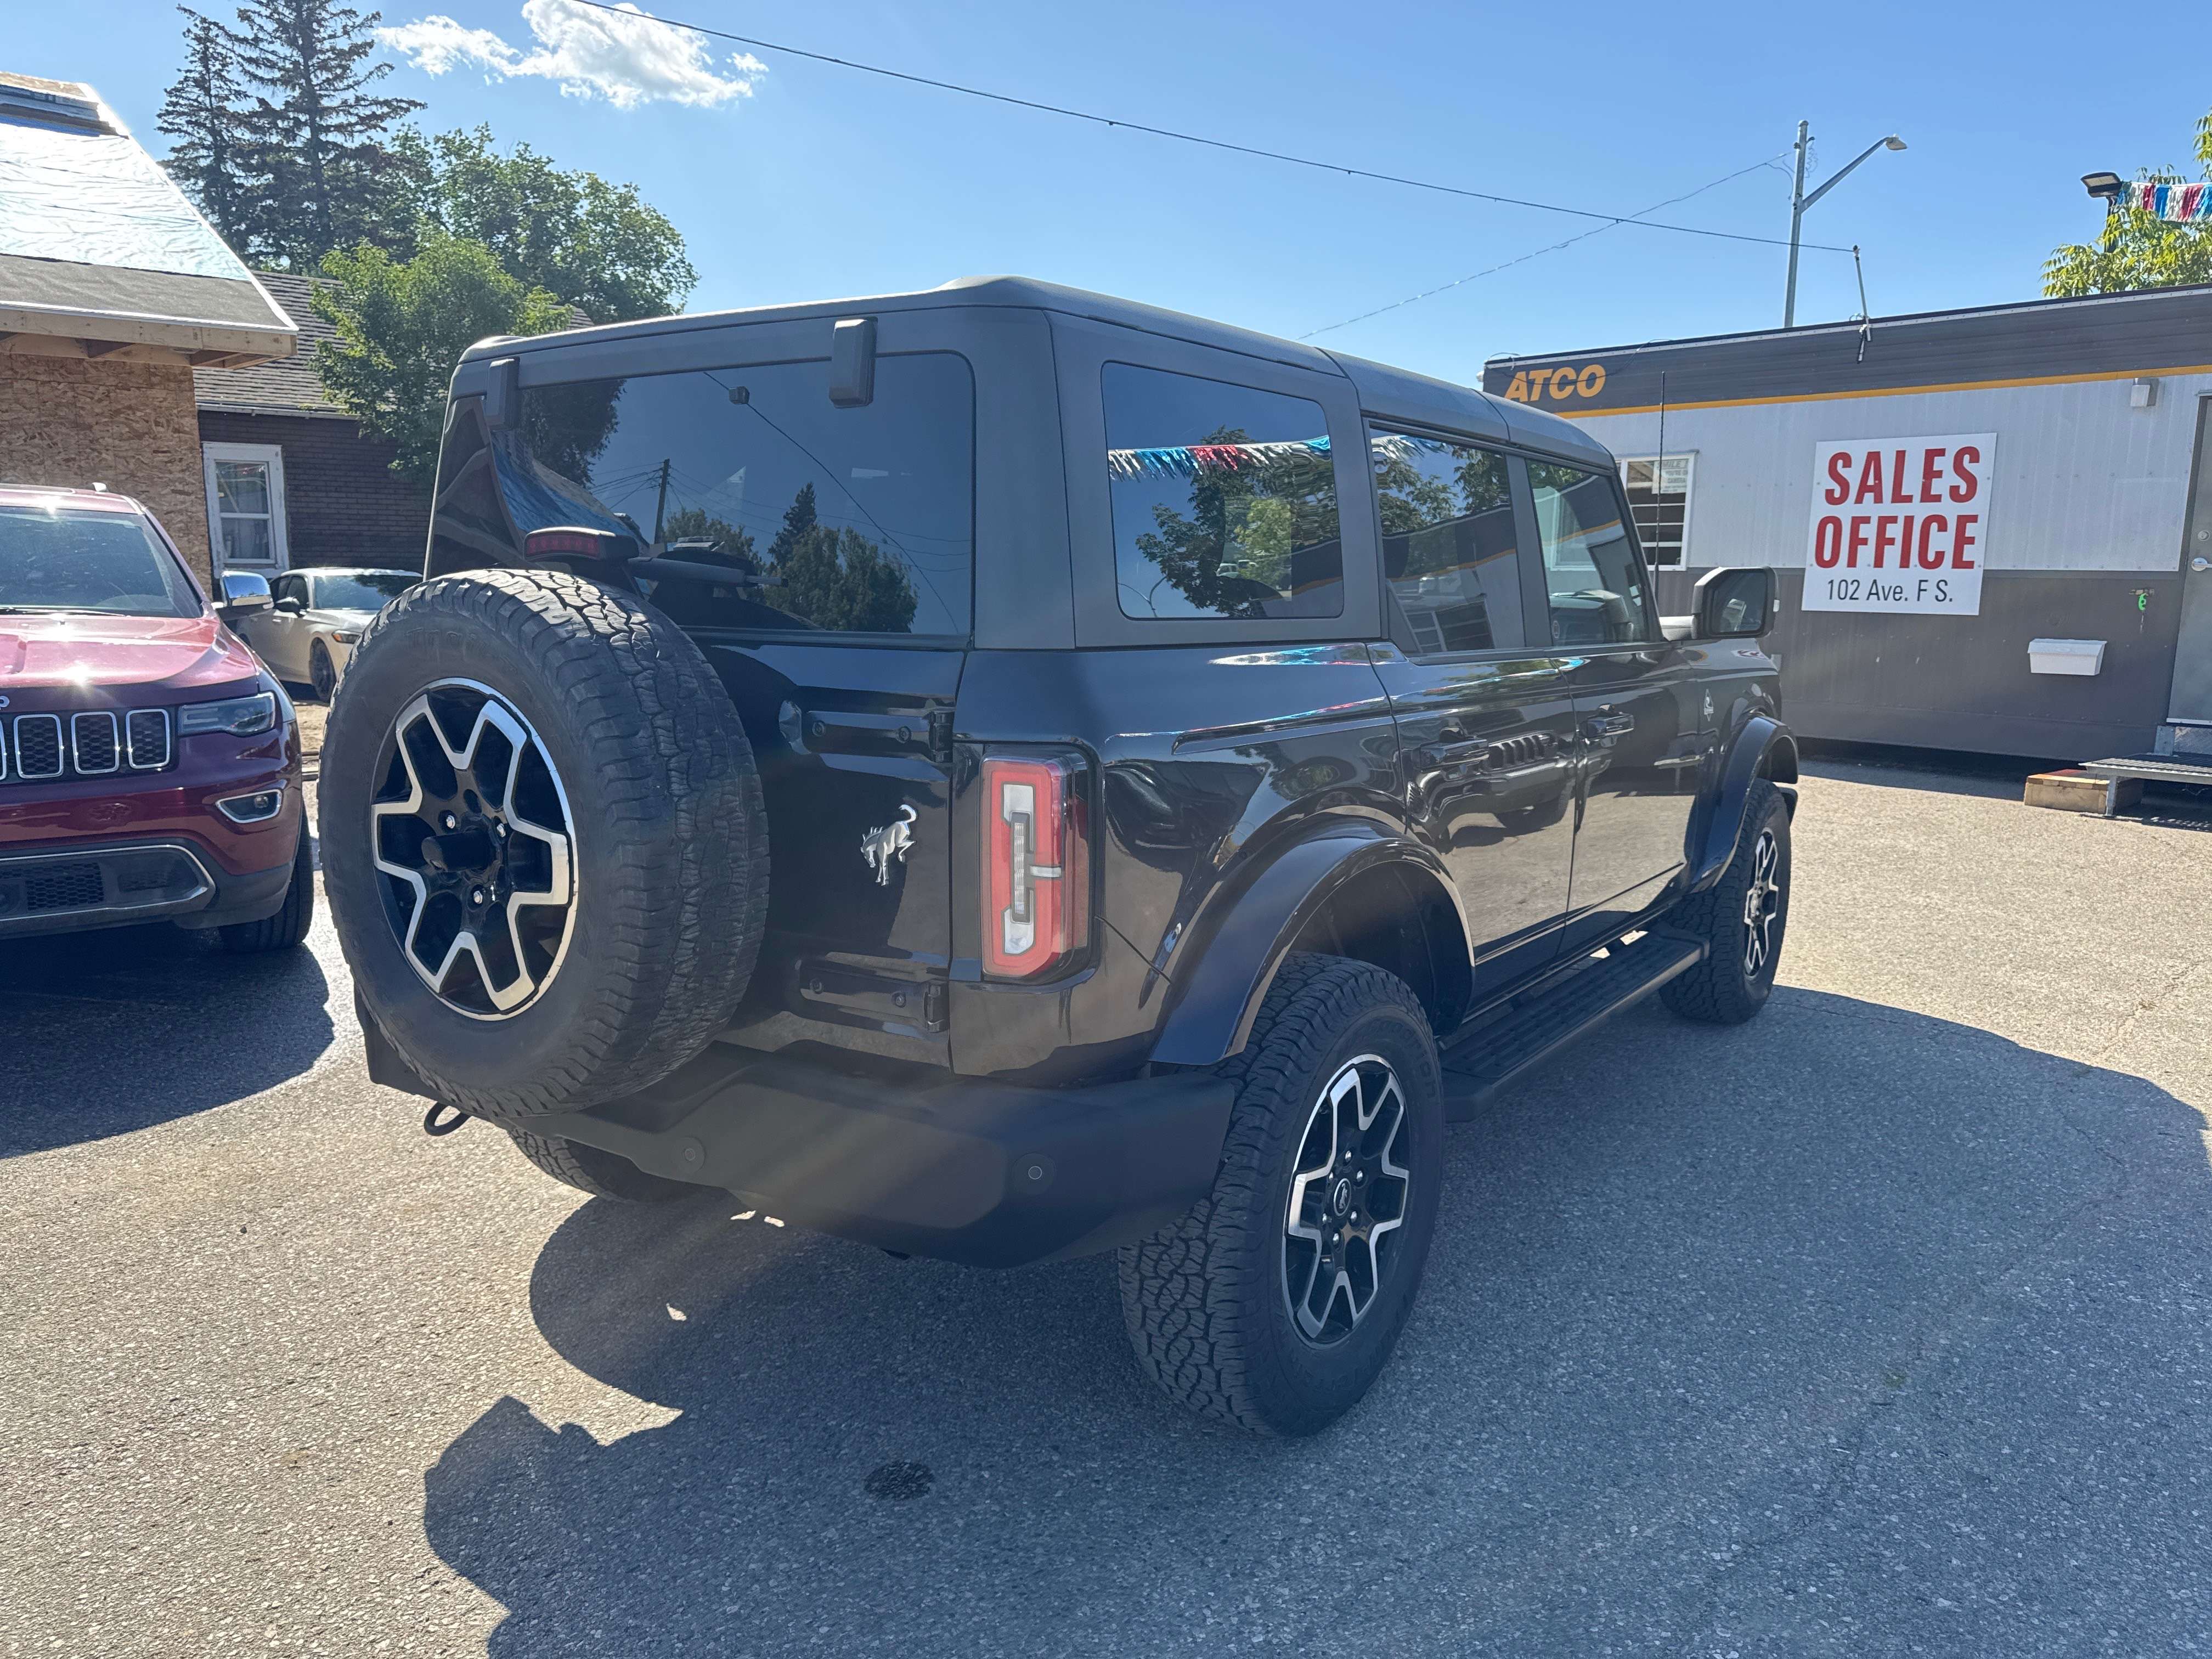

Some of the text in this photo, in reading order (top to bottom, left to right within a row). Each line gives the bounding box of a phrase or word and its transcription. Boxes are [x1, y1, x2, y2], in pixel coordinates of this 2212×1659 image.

[1505, 364, 1605, 402] ATCO
[1825, 446, 1980, 505] SALES
[1815, 515, 1978, 569] OFFICE
[1828, 579, 1860, 600] 102
[1866, 579, 1908, 601] Ave.
